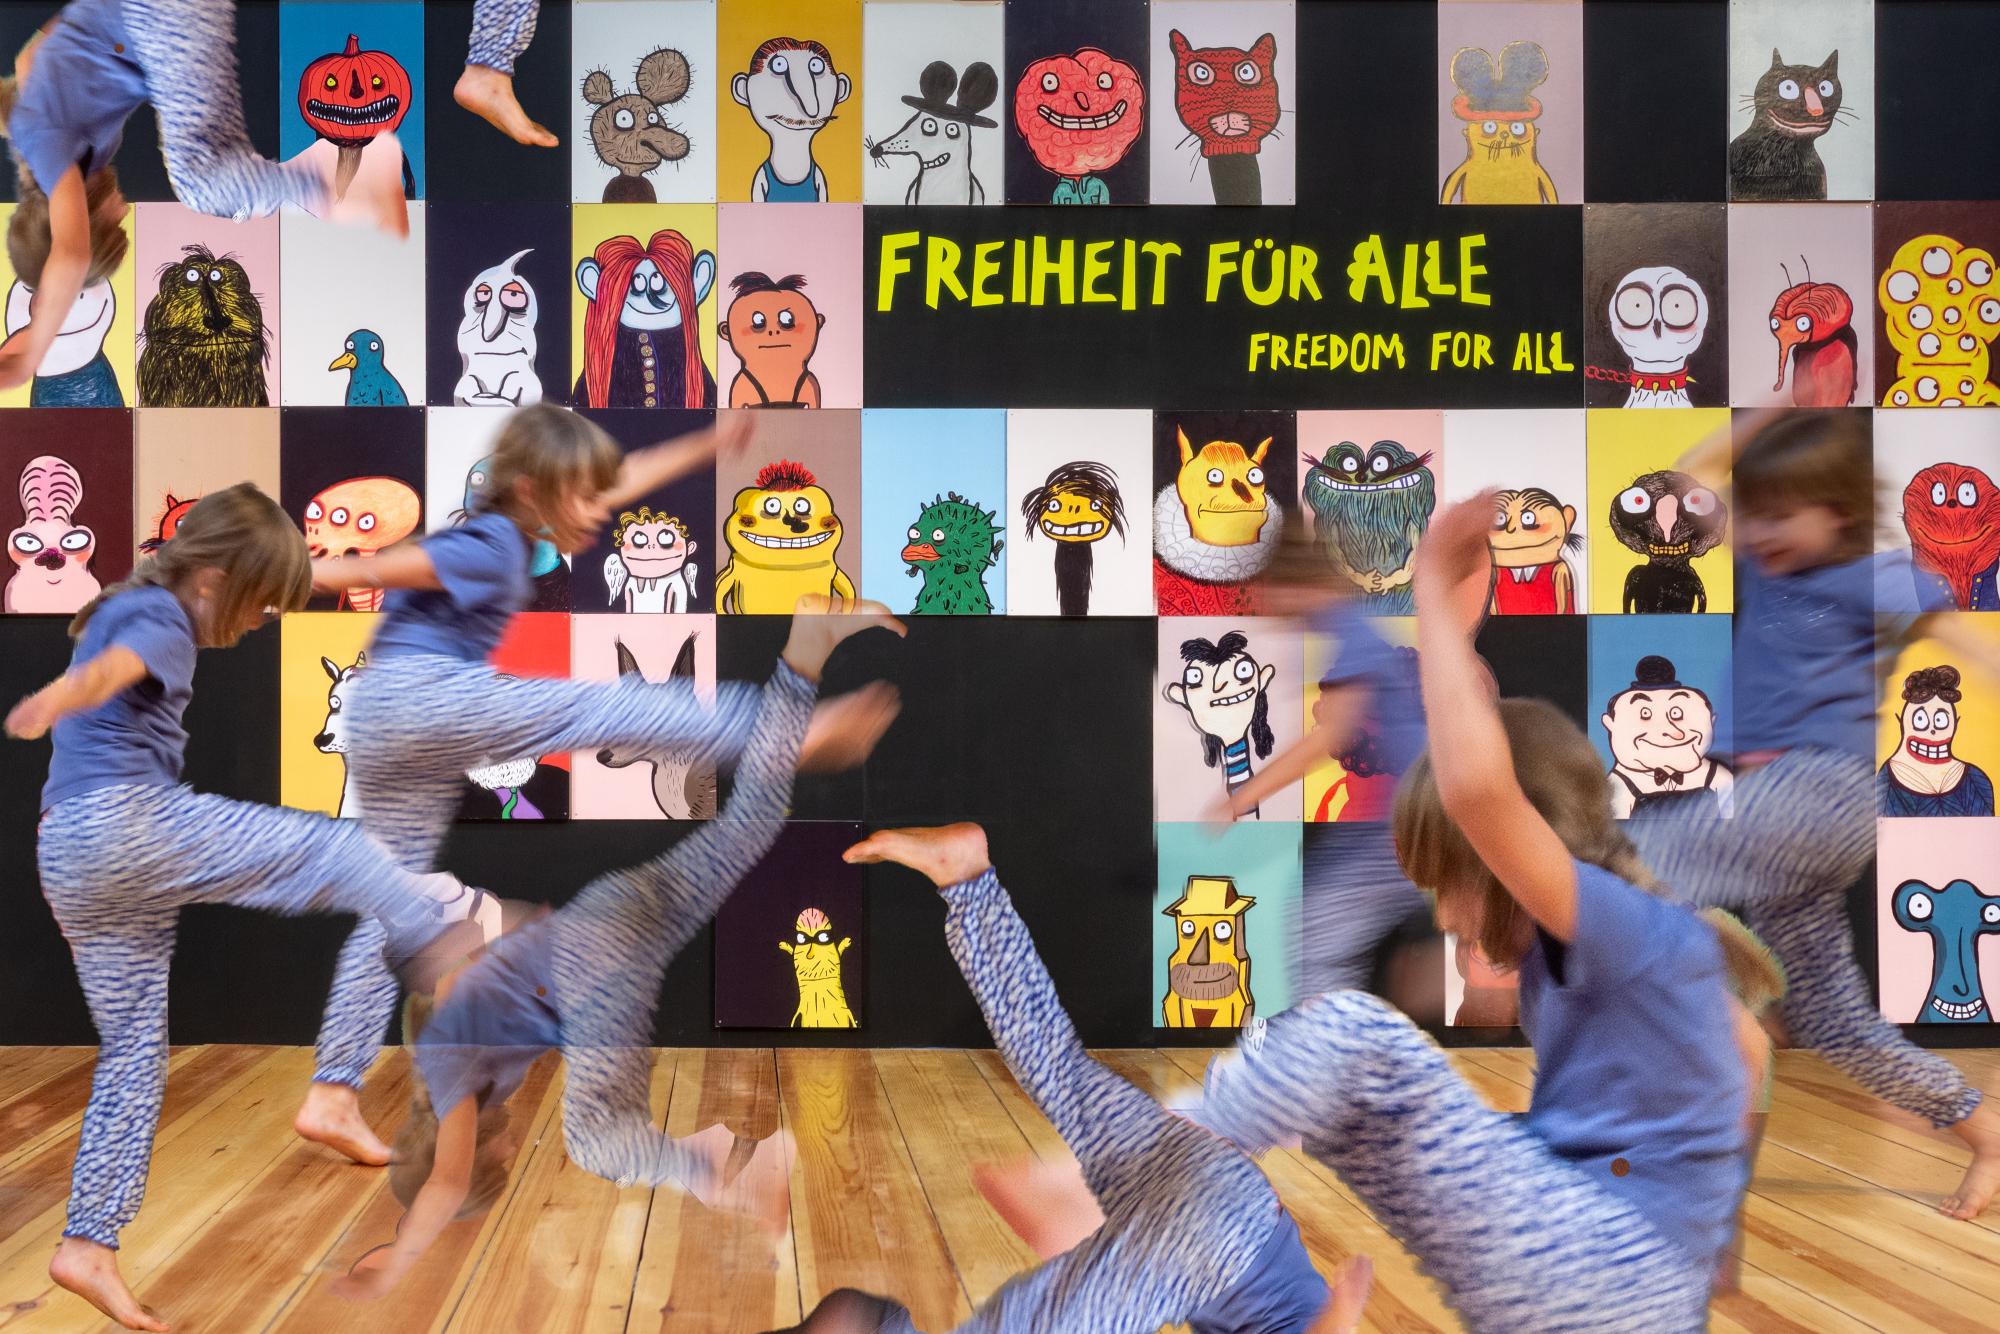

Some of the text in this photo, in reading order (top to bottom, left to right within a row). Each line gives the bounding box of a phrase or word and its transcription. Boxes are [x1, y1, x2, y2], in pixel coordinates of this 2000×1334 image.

[877, 230, 1492, 312] FREIHEIT FÜR ALLE
[1248, 331, 1575, 375] FREEDOM FOR ALL
